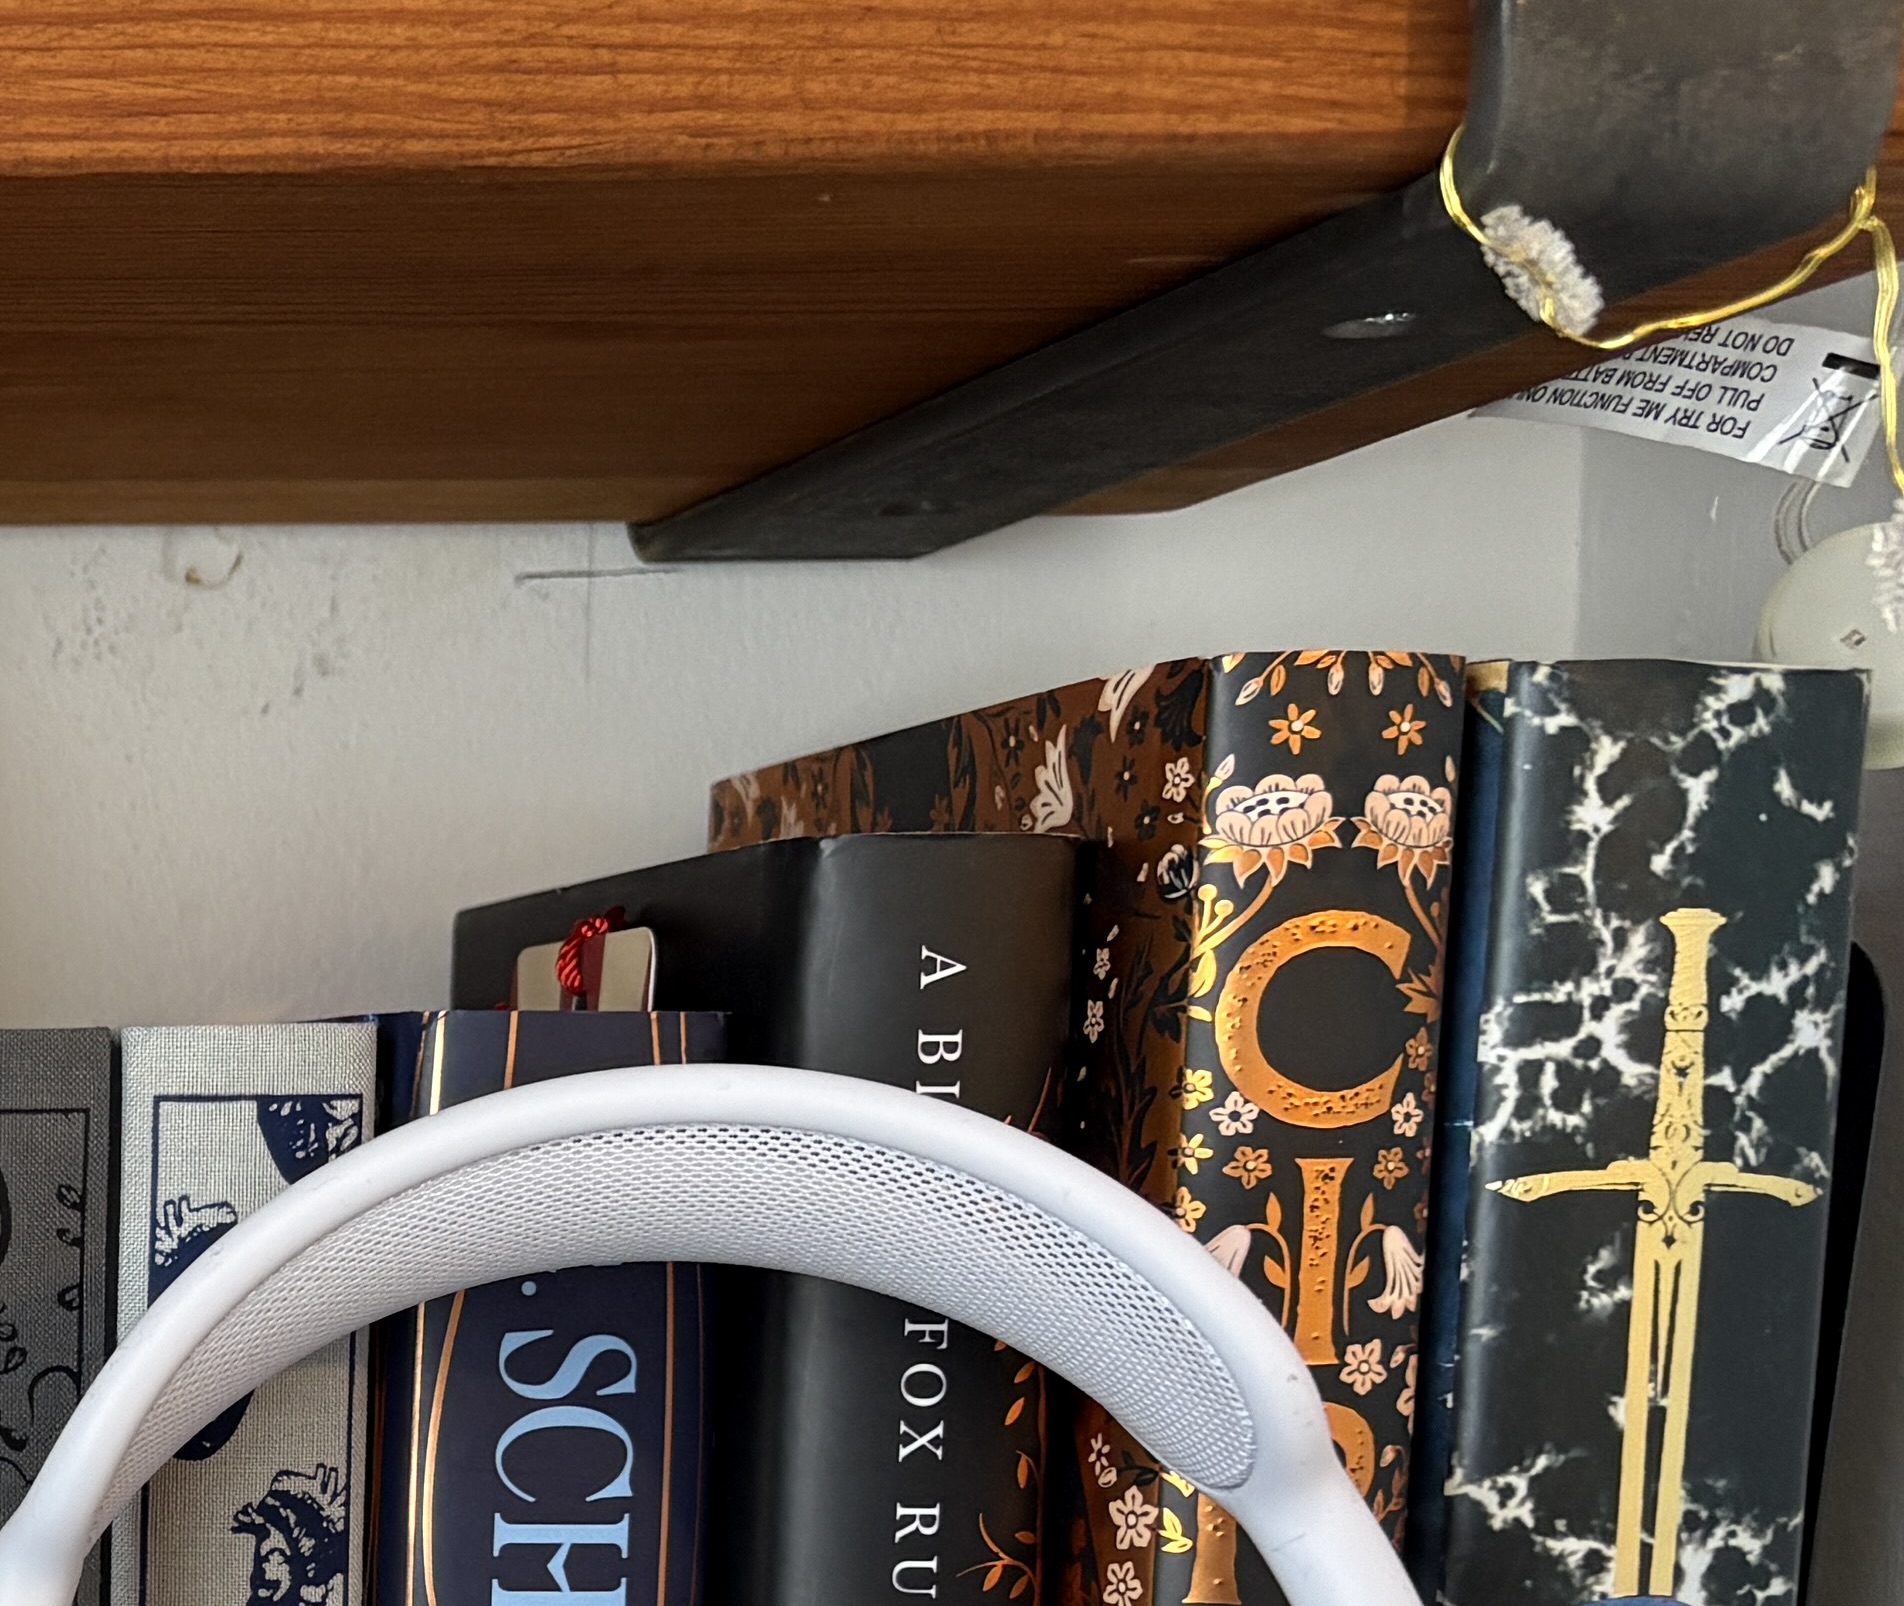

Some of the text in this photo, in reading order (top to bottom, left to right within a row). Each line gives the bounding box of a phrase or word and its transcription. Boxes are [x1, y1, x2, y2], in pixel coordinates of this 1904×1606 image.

[1717, 328, 1763, 352] NOT
[1763, 335, 1795, 356] DO
[1635, 346, 1778, 383] COMPARTMENT
[1615, 369, 1673, 393] FROM
[1672, 381, 1712, 402] OFF
[1545, 386, 1634, 414] FUNCTION
[1632, 399, 1666, 419] ME
[1718, 385, 1765, 412] PULL
[1665, 406, 1705, 430] TRY
[1707, 415, 1752, 439] FOR
[919, 944, 968, 990] A
[897, 1317, 949, 1463] FOX
